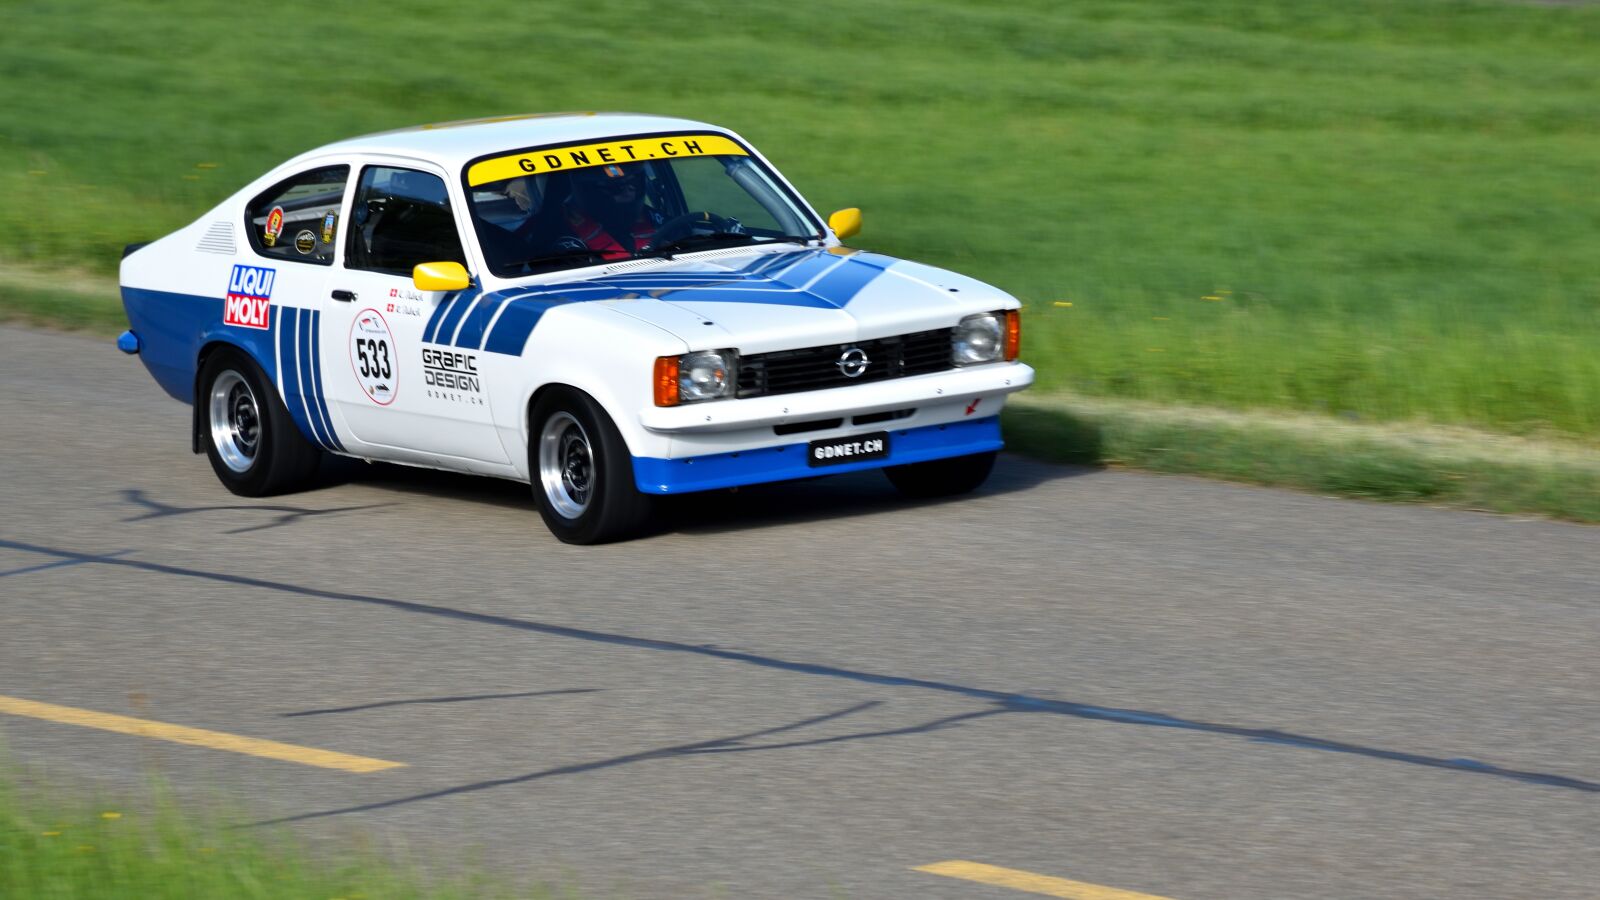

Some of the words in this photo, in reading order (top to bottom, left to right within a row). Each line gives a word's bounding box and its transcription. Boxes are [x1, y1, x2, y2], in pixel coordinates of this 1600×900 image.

[519, 140, 704, 173] GDNET.CH
[230, 266, 275, 296] LIQUI
[226, 296, 269, 326] MOLY
[356, 338, 392, 380] 533
[424, 370, 480, 393] DESIGN
[814, 439, 883, 459] GDNET.CH
